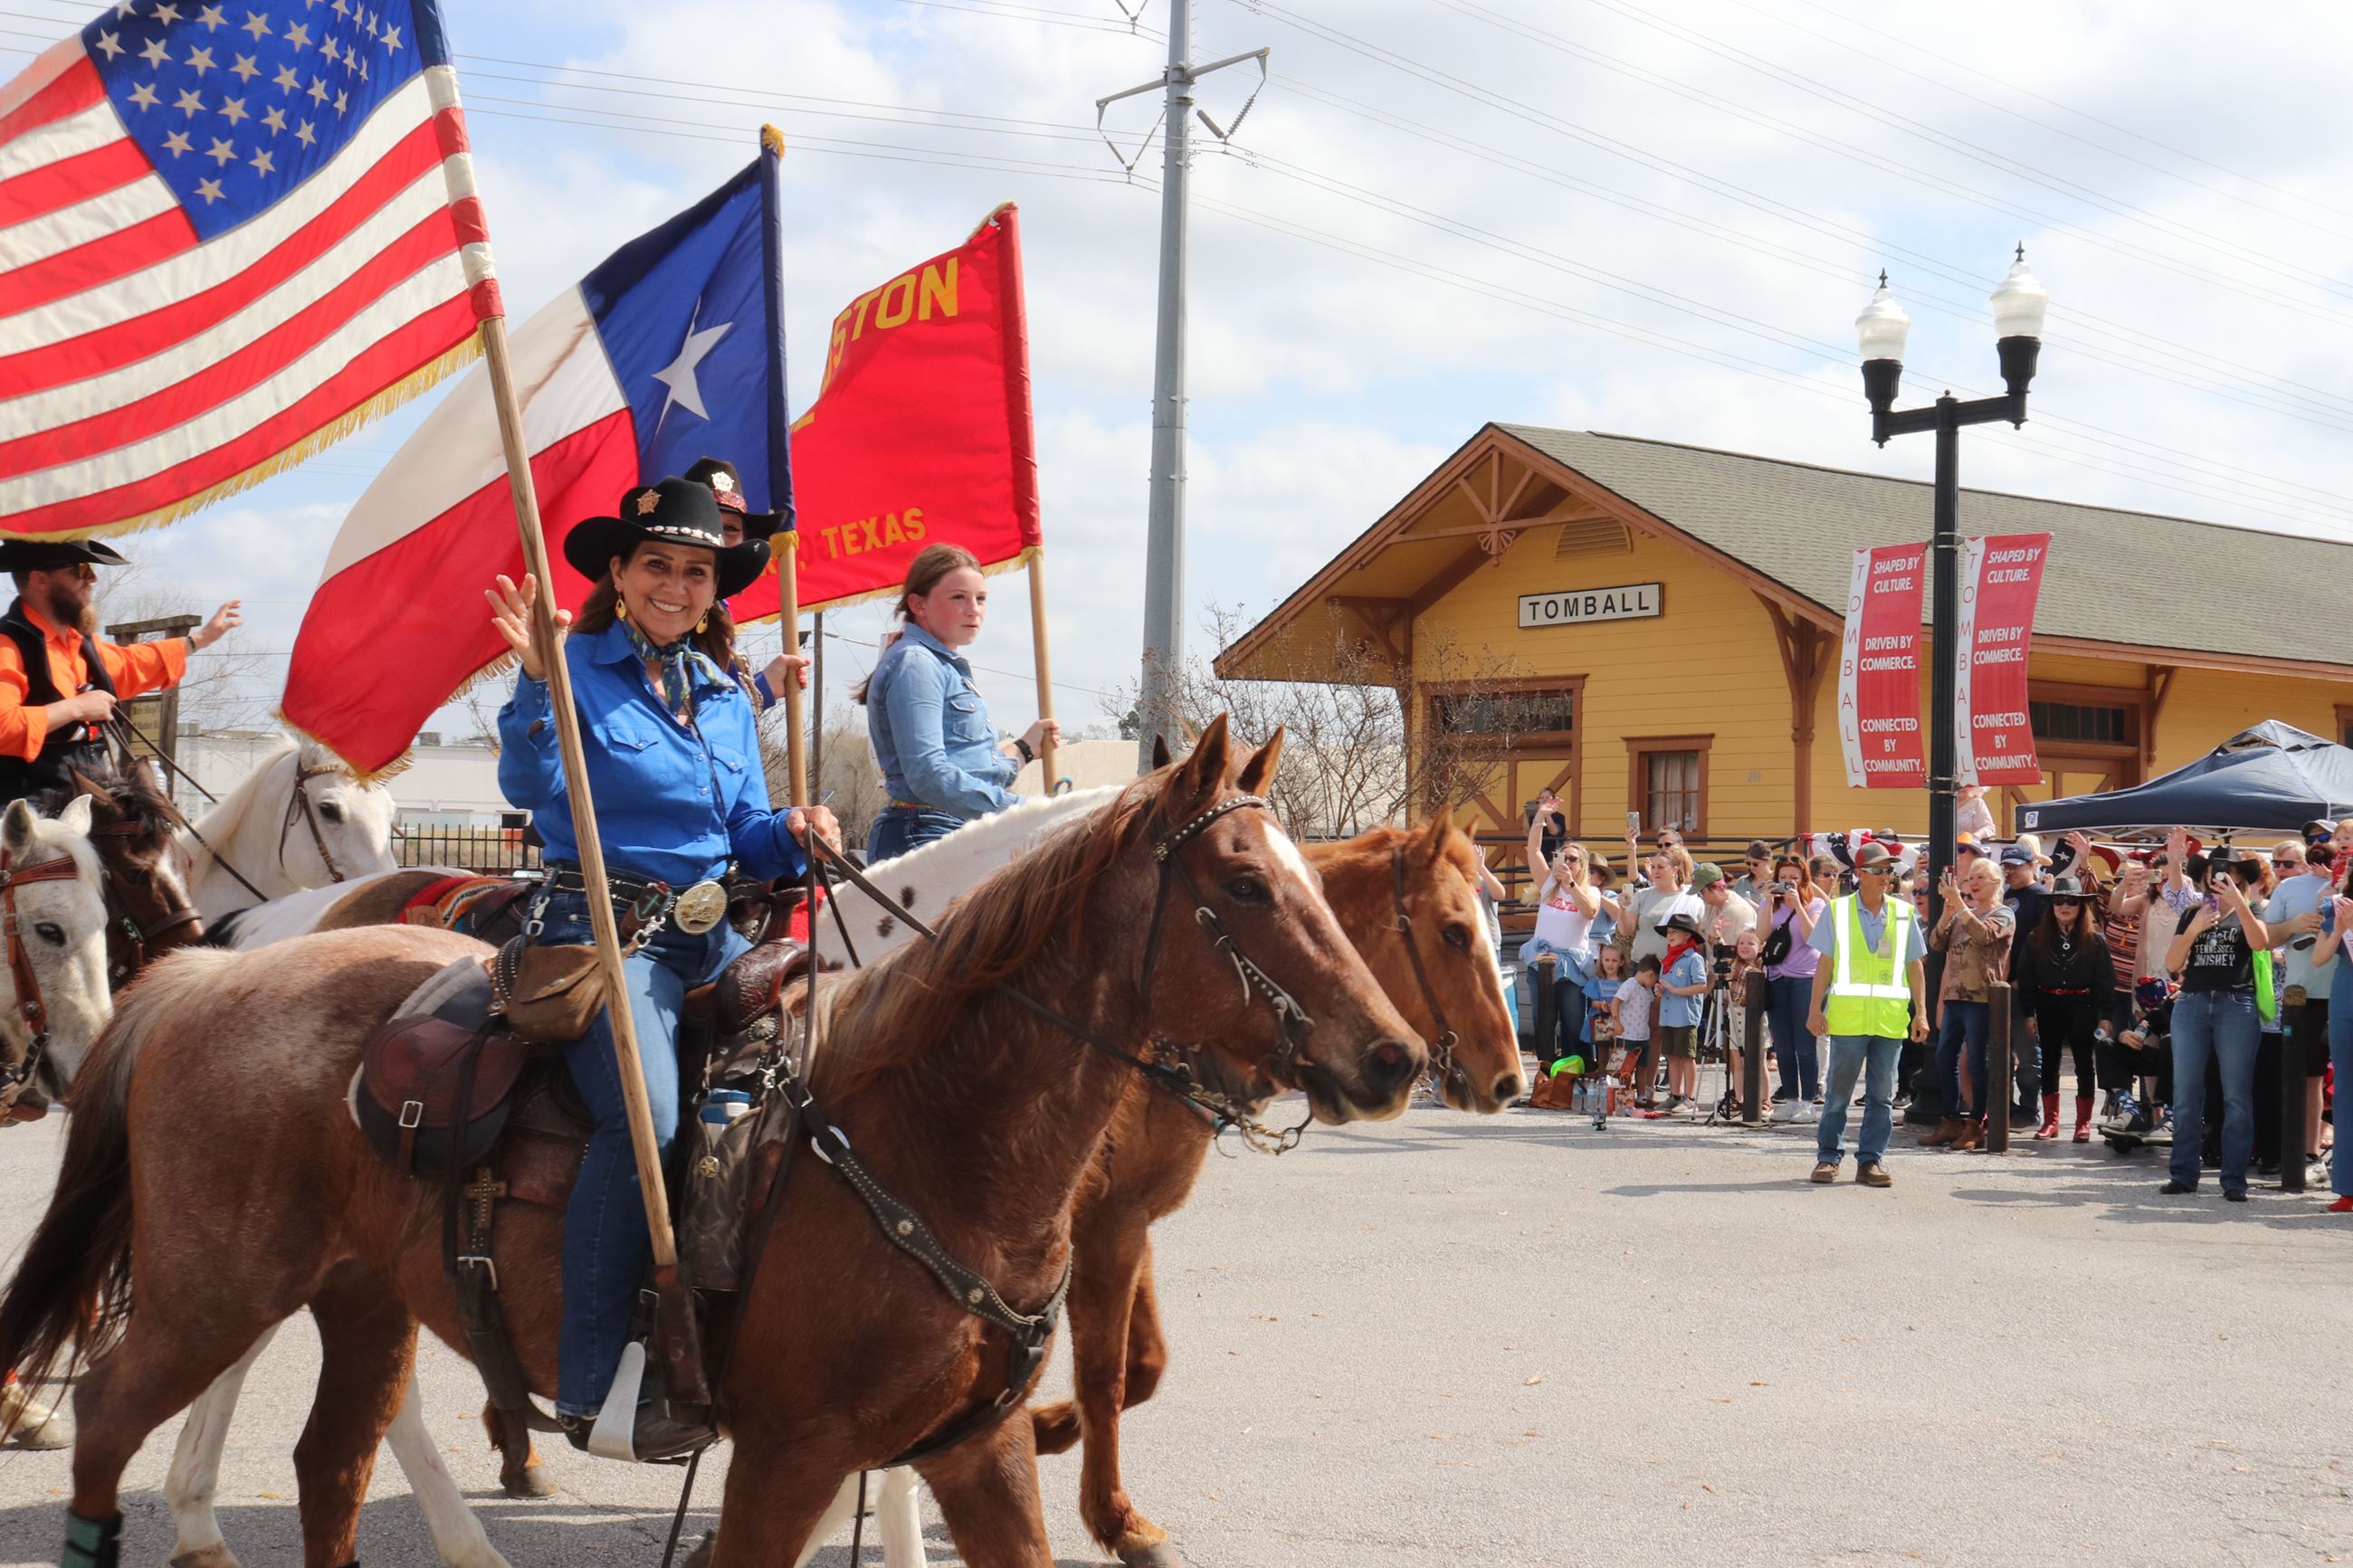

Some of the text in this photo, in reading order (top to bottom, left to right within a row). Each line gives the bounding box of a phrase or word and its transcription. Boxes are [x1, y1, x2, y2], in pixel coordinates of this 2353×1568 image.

[820, 508, 928, 559] TEXAS
[1987, 547, 2042, 564] SHAPED BY
[1873, 556, 1920, 575] SHAPED BY
[1986, 568, 2030, 584] CULTURE.
[1873, 576, 1913, 594] CULTURE.
[1529, 591, 1650, 621] TOMBALL
[1865, 634, 1913, 651] DRIVEN BY
[1977, 626, 2024, 643] DRIVEN BY
[1861, 655, 1916, 671] COMMERCE.
[1957, 553, 1979, 773] TOMBALL
[1974, 648, 2024, 665] COMMERCE.
[1841, 565, 1864, 774] TOMBALL
[1861, 717, 1918, 733] CONNECTED
[1973, 712, 2026, 728] CONNECTED
[1884, 738, 1897, 752] BY
[1995, 735, 2006, 748] BY
[1864, 758, 1925, 774] COMMUNITY.
[1975, 754, 2036, 770] COMMUNITY.
